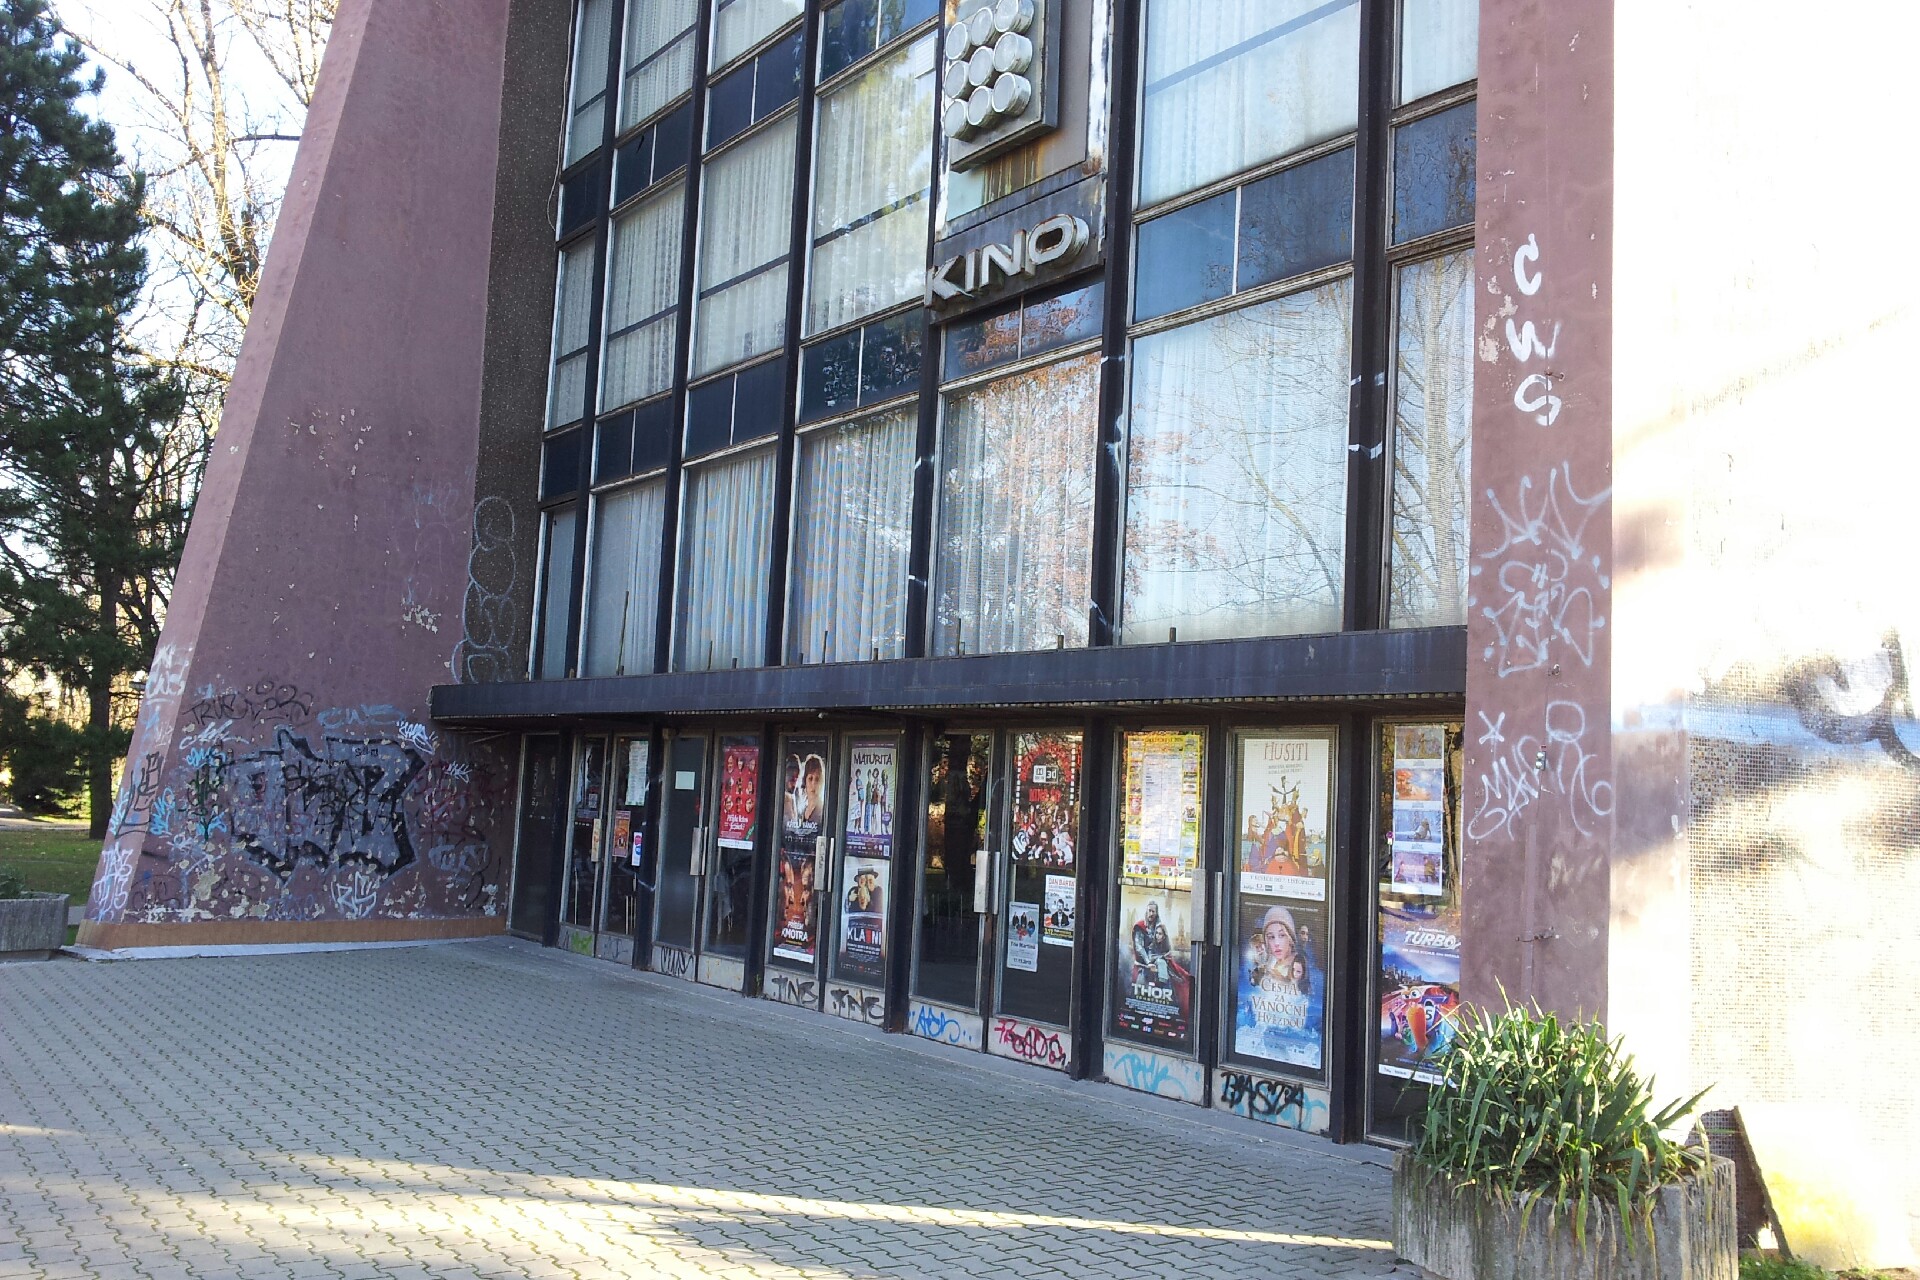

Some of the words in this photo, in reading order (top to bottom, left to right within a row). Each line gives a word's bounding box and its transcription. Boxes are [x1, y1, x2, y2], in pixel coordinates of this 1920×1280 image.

[929, 213, 1090, 301] KINO
[853, 751, 893, 766] MATURITA
[1263, 741, 1309, 761] HUSITI
[1404, 930, 1459, 950] TURBO
[1131, 982, 1174, 1002] THOR
[1261, 977, 1298, 996] CESTA
